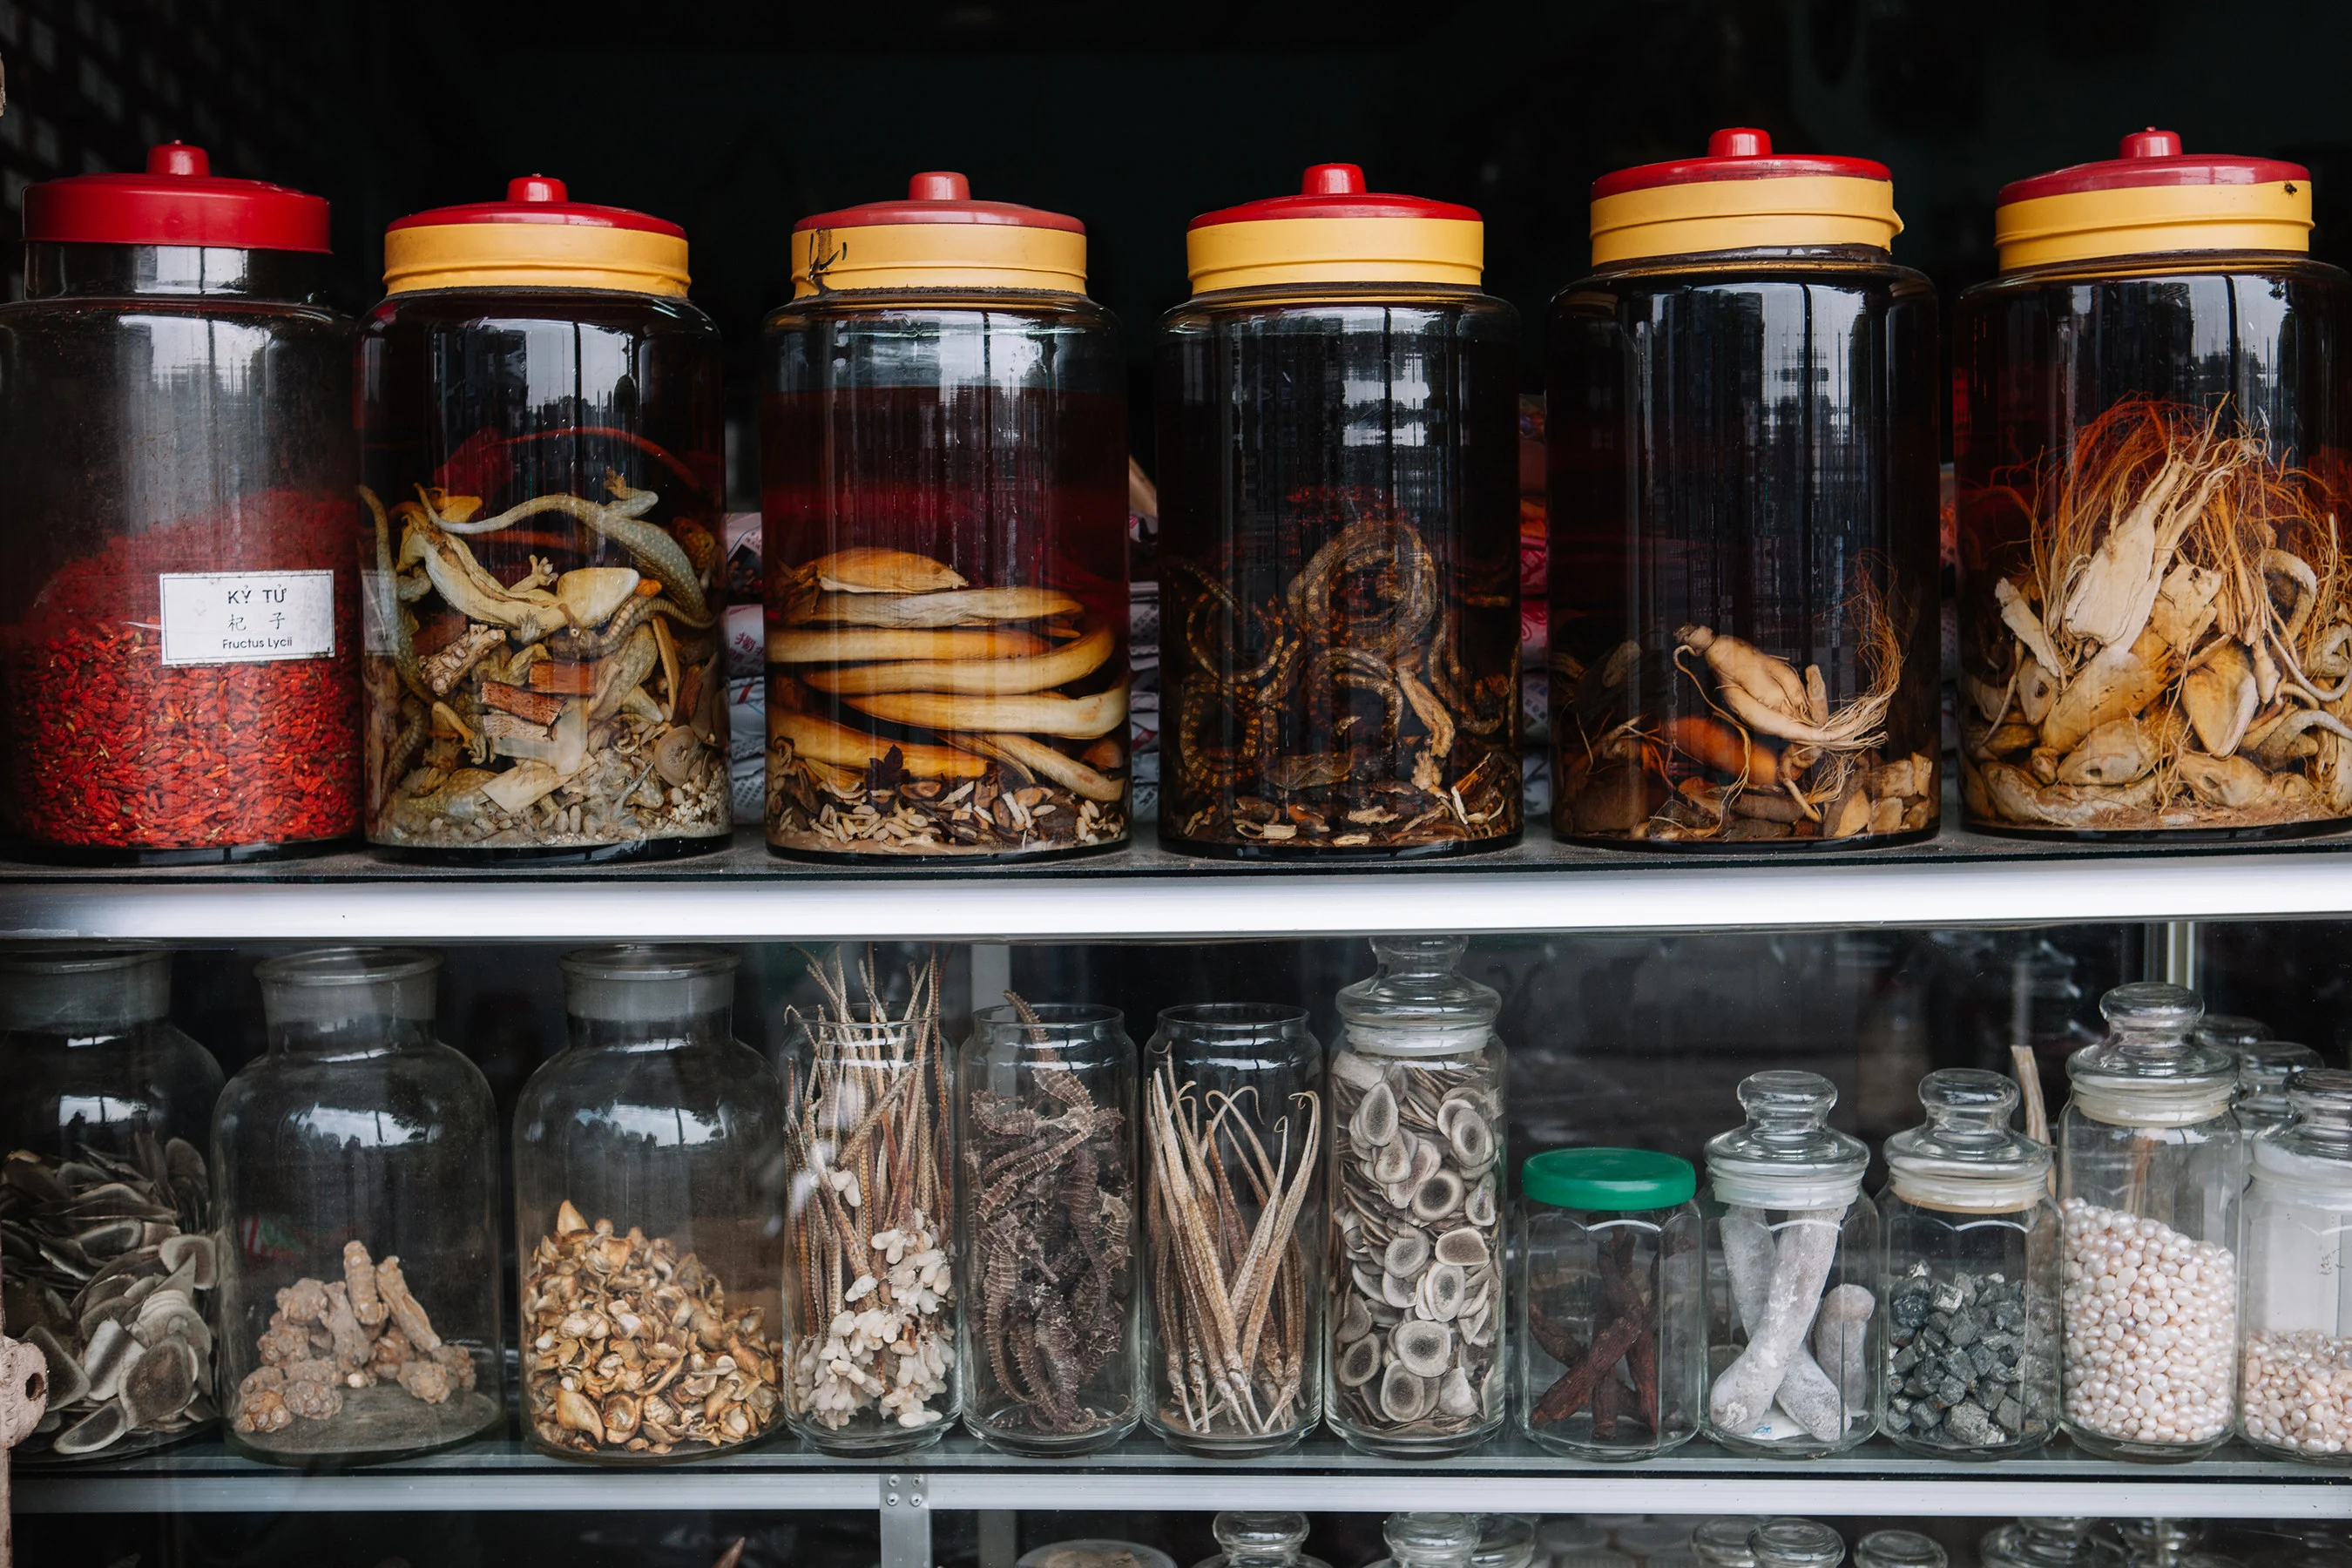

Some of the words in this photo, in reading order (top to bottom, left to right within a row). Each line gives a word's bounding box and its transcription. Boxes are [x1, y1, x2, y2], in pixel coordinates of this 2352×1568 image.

[228, 585, 253, 604] KỶ
[262, 584, 287, 603] TỬ
[222, 639, 265, 650] Fructus
[267, 637, 293, 649] Lycii
